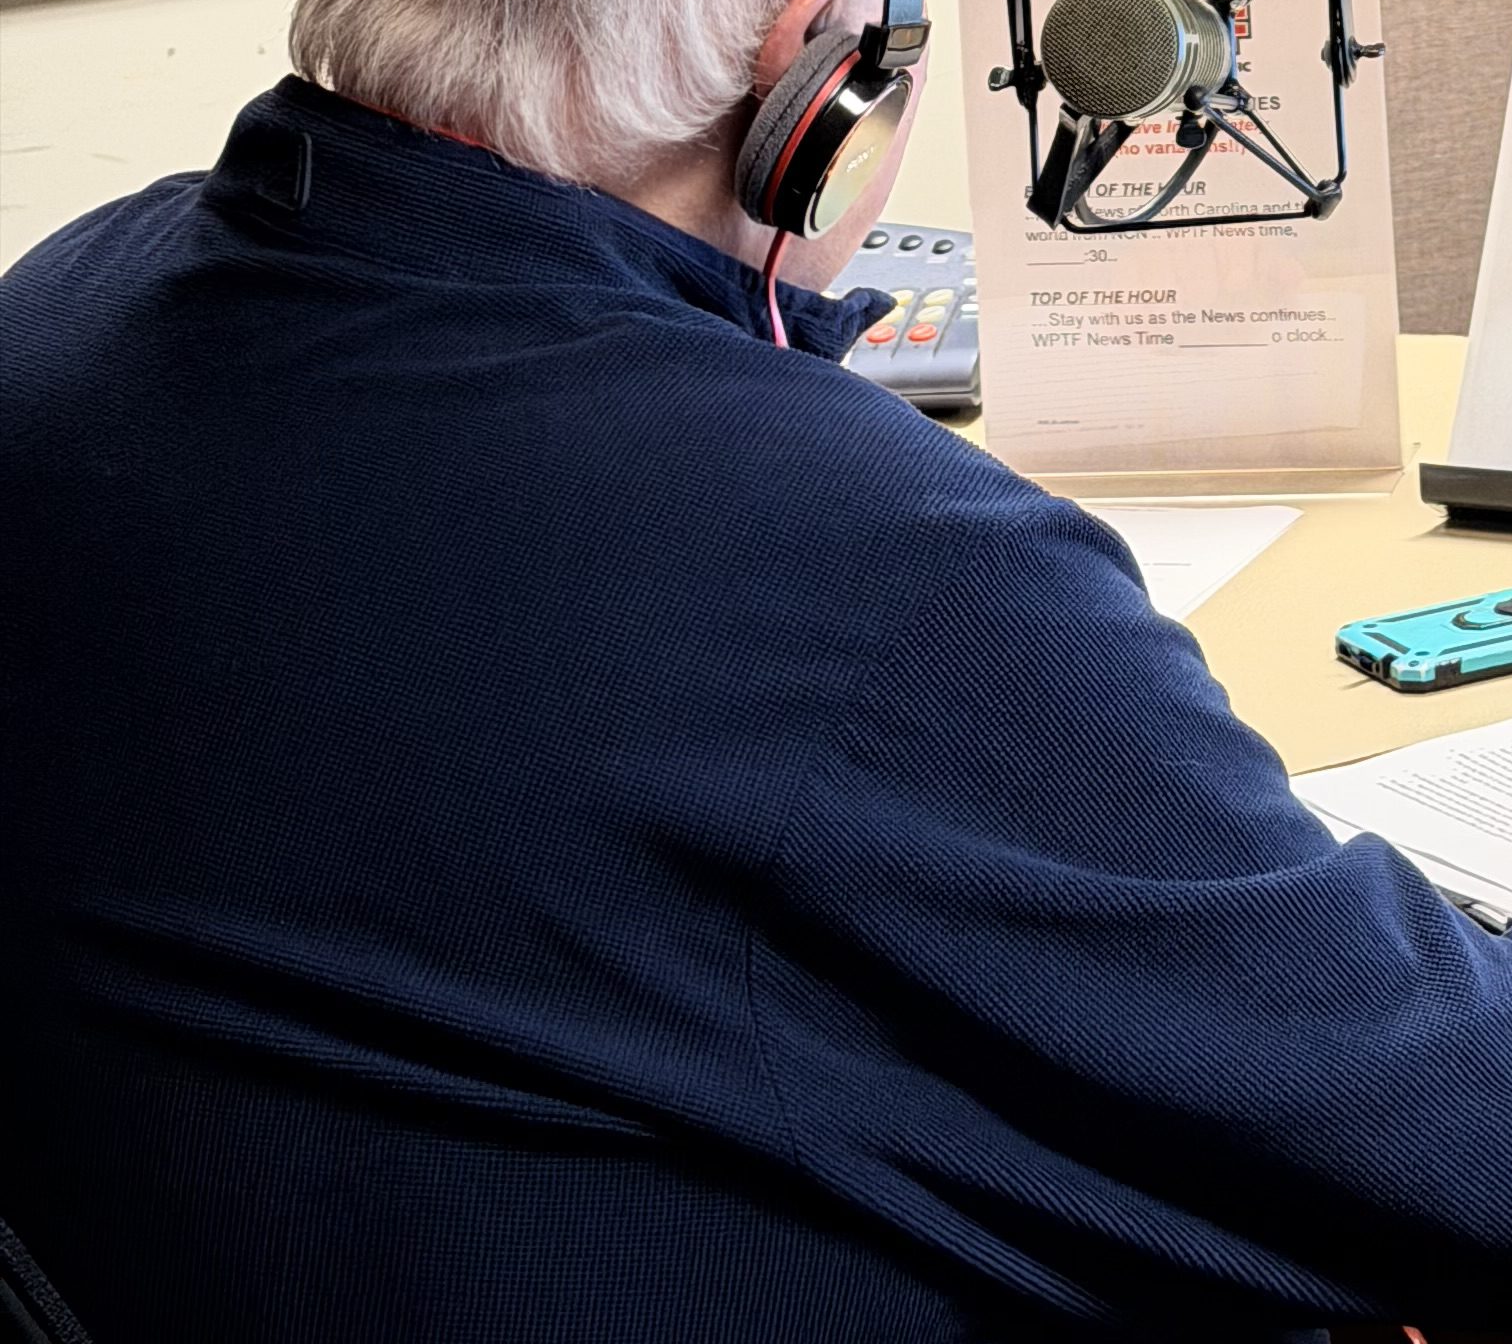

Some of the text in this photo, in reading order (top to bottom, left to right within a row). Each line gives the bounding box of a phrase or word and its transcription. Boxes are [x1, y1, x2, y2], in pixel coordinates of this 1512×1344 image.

[1096, 183, 1122, 196] OF
[1123, 182, 1154, 196] THE
[1162, 203, 1192, 217] orth
[1193, 202, 1259, 217] Carolina
[1263, 201, 1287, 215] and
[1212, 226, 1256, 238] News
[1030, 289, 1177, 307] TOP OF THE HOUR
[1088, 312, 1120, 326] with
[1125, 315, 1144, 325] us
[1148, 314, 1167, 325] as
[1171, 310, 1196, 325] the
[1201, 309, 1246, 324] News
[1031, 332, 1081, 348] WPTF
[1087, 332, 1131, 347] News
[1135, 330, 1175, 346] Time
